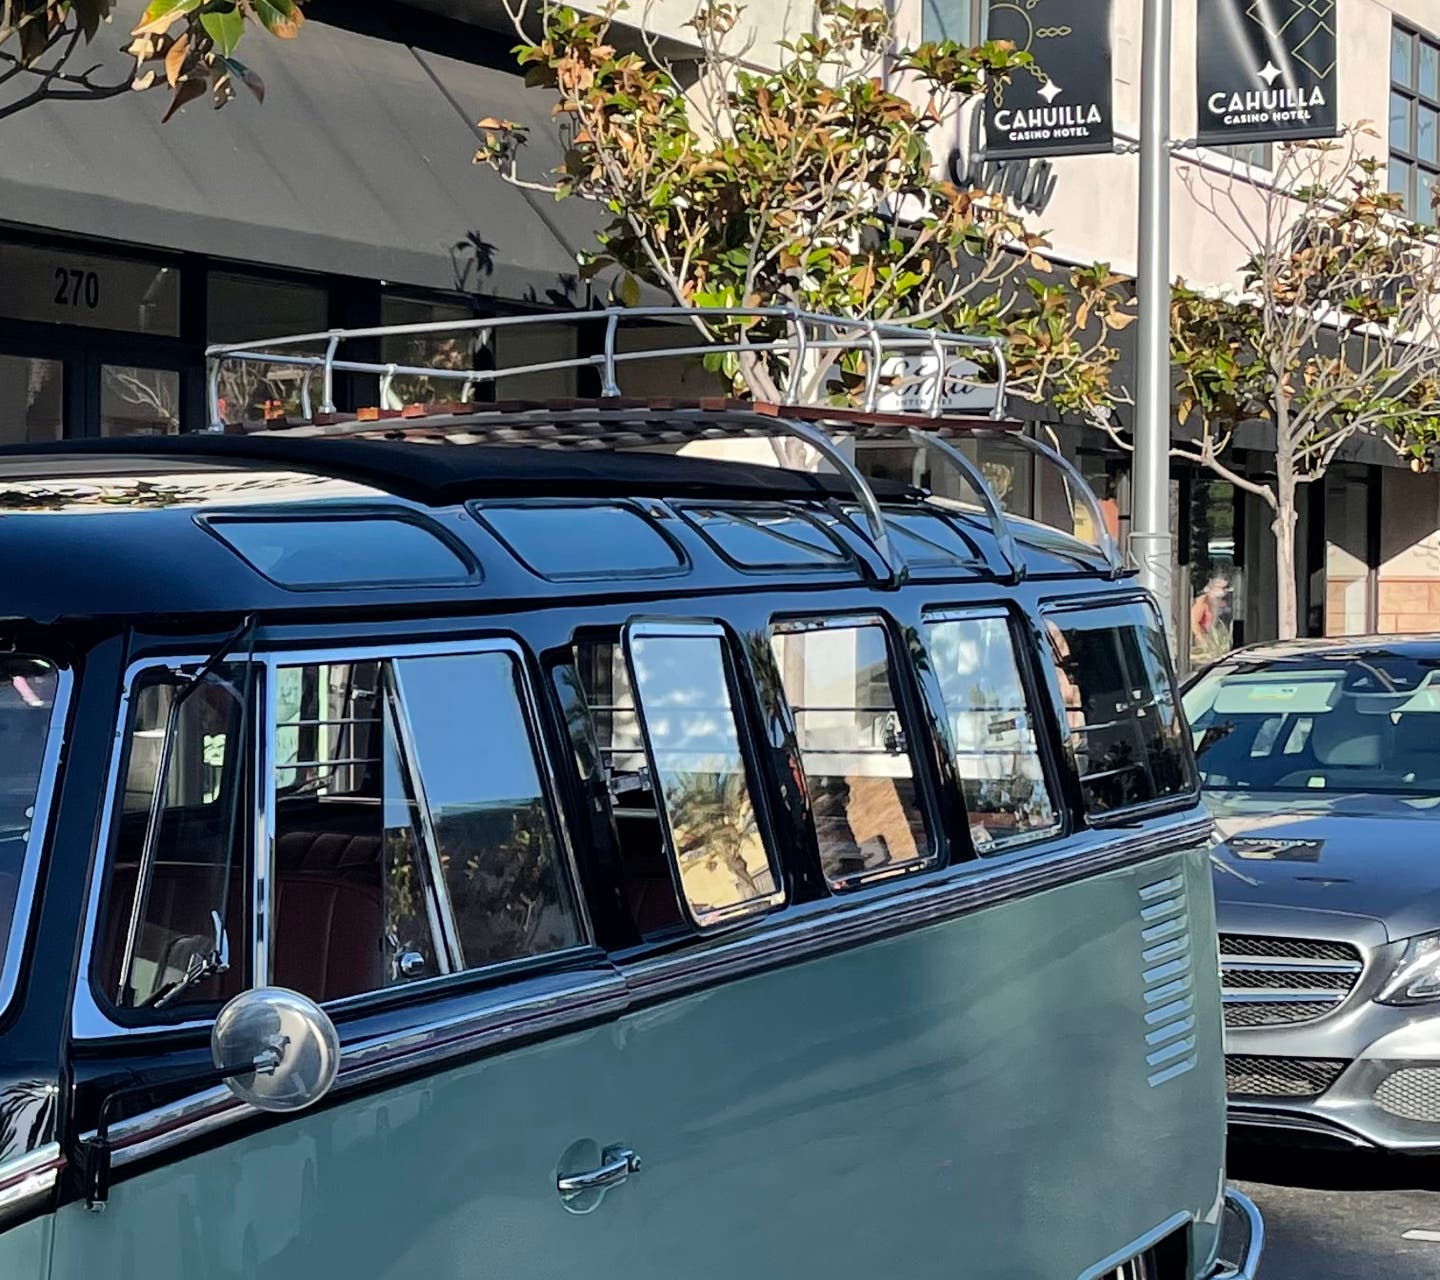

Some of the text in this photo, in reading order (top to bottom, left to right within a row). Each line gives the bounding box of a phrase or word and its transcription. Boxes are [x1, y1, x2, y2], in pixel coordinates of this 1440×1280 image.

[1208, 85, 1326, 114] CAHUILLA
[994, 103, 1102, 131] CAHUILLA
[1223, 109, 1312, 125] CASINO HOTEL
[1009, 126, 1090, 141] CASINO HOTEL
[53, 267, 100, 309] 270
